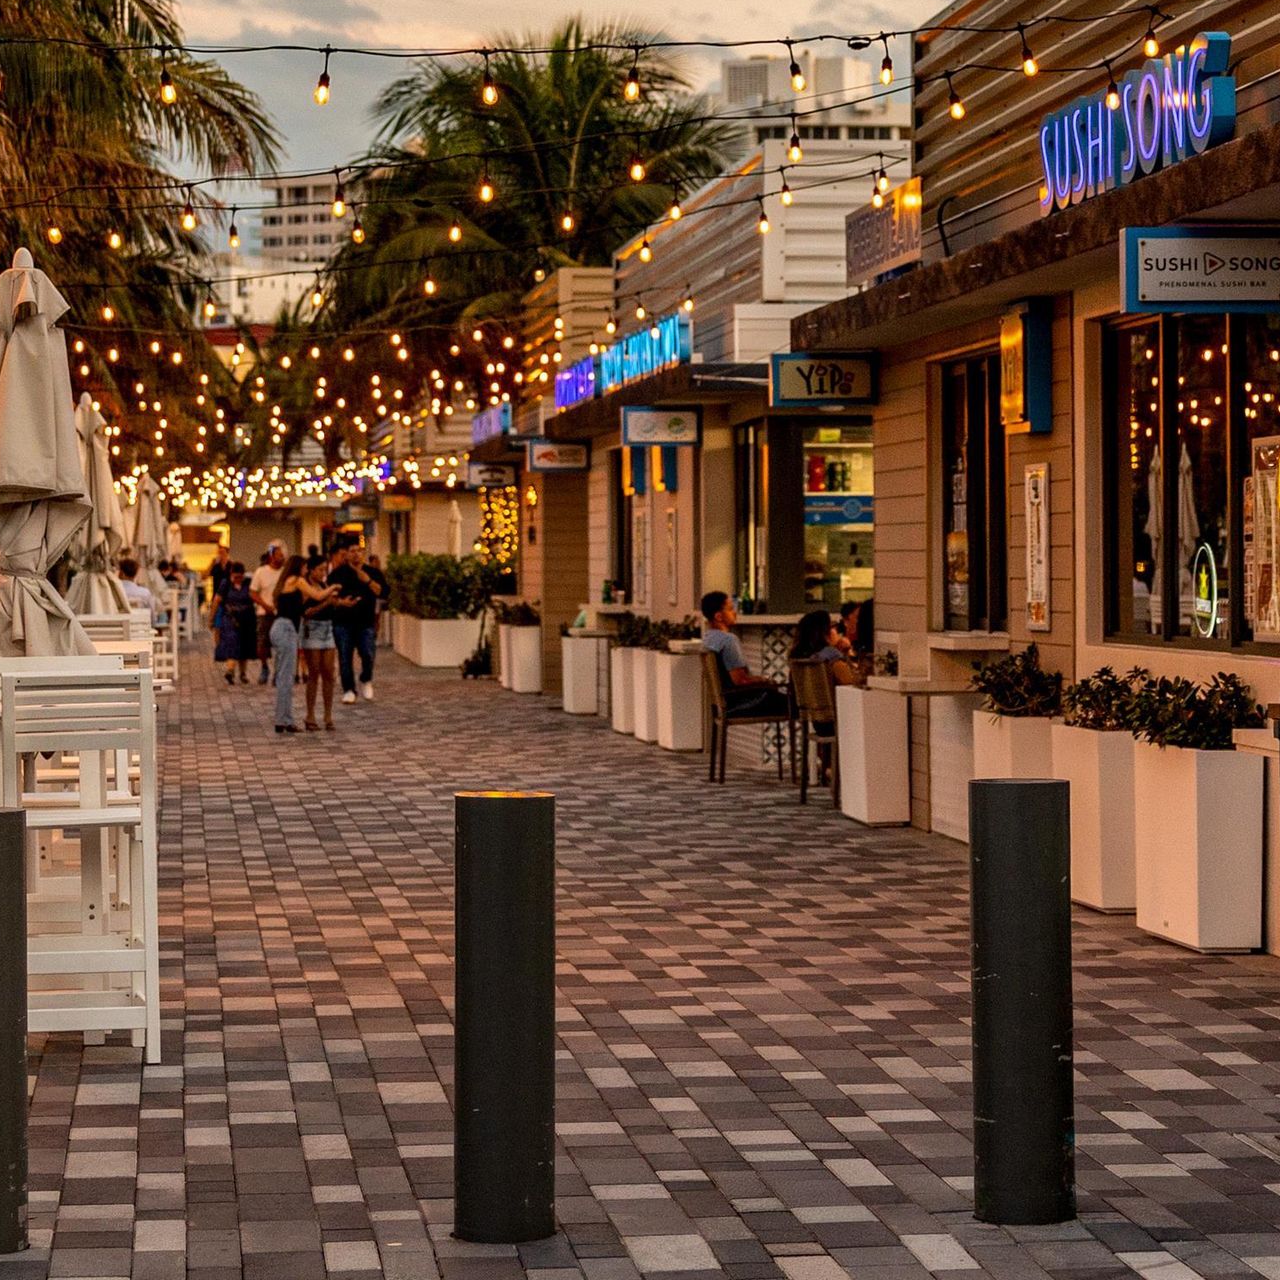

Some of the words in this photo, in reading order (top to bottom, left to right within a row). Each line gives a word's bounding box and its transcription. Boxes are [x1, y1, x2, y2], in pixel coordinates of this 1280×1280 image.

[1039, 88, 1120, 217] SUSHI
[1121, 32, 1235, 184] SONG
[1143, 257, 1198, 271] SUSHI
[1159, 280, 1217, 288] PHENOMENAL
